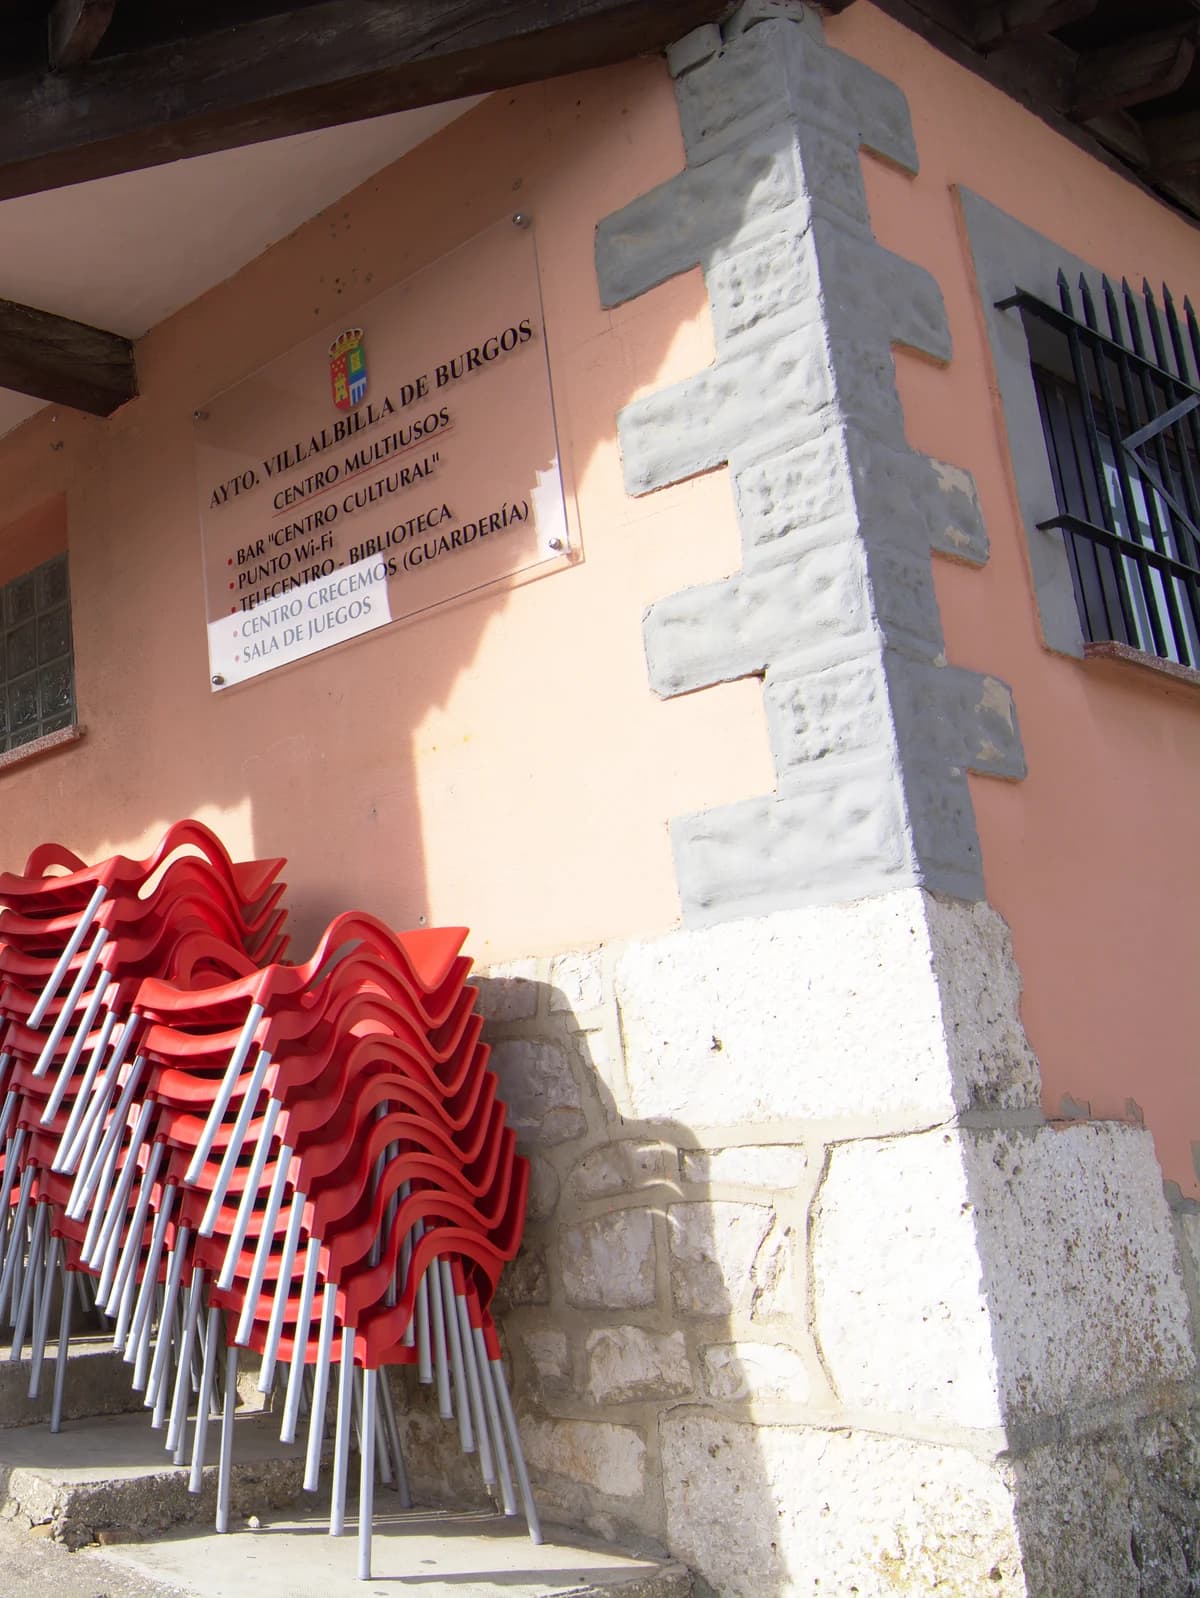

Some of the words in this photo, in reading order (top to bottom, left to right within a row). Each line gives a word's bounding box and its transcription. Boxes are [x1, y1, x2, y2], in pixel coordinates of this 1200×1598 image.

[210, 470, 260, 509] AYTO.
[263, 396, 395, 478] VILLALBILLA
[400, 375, 429, 407] DE
[435, 318, 532, 388] BURGOS
[273, 464, 339, 510] CENTRO
[344, 407, 450, 475] MULTIUSOS
[236, 539, 265, 565] BAR
[268, 504, 338, 546] "CENTRO
[343, 452, 440, 513] CULTURAL"
[238, 552, 291, 589] PUNTO
[294, 531, 334, 562] Wi-Fi
[240, 558, 335, 612] TELECENTRO
[349, 504, 452, 565] BIBLIOTECA
[241, 599, 303, 638] CENTRO
[307, 557, 398, 609] CRECEMOS
[403, 501, 529, 571] (GUARDERÍA)
[243, 636, 280, 663] SALA
[283, 624, 304, 647] DE
[308, 596, 372, 640] JUEGOS
